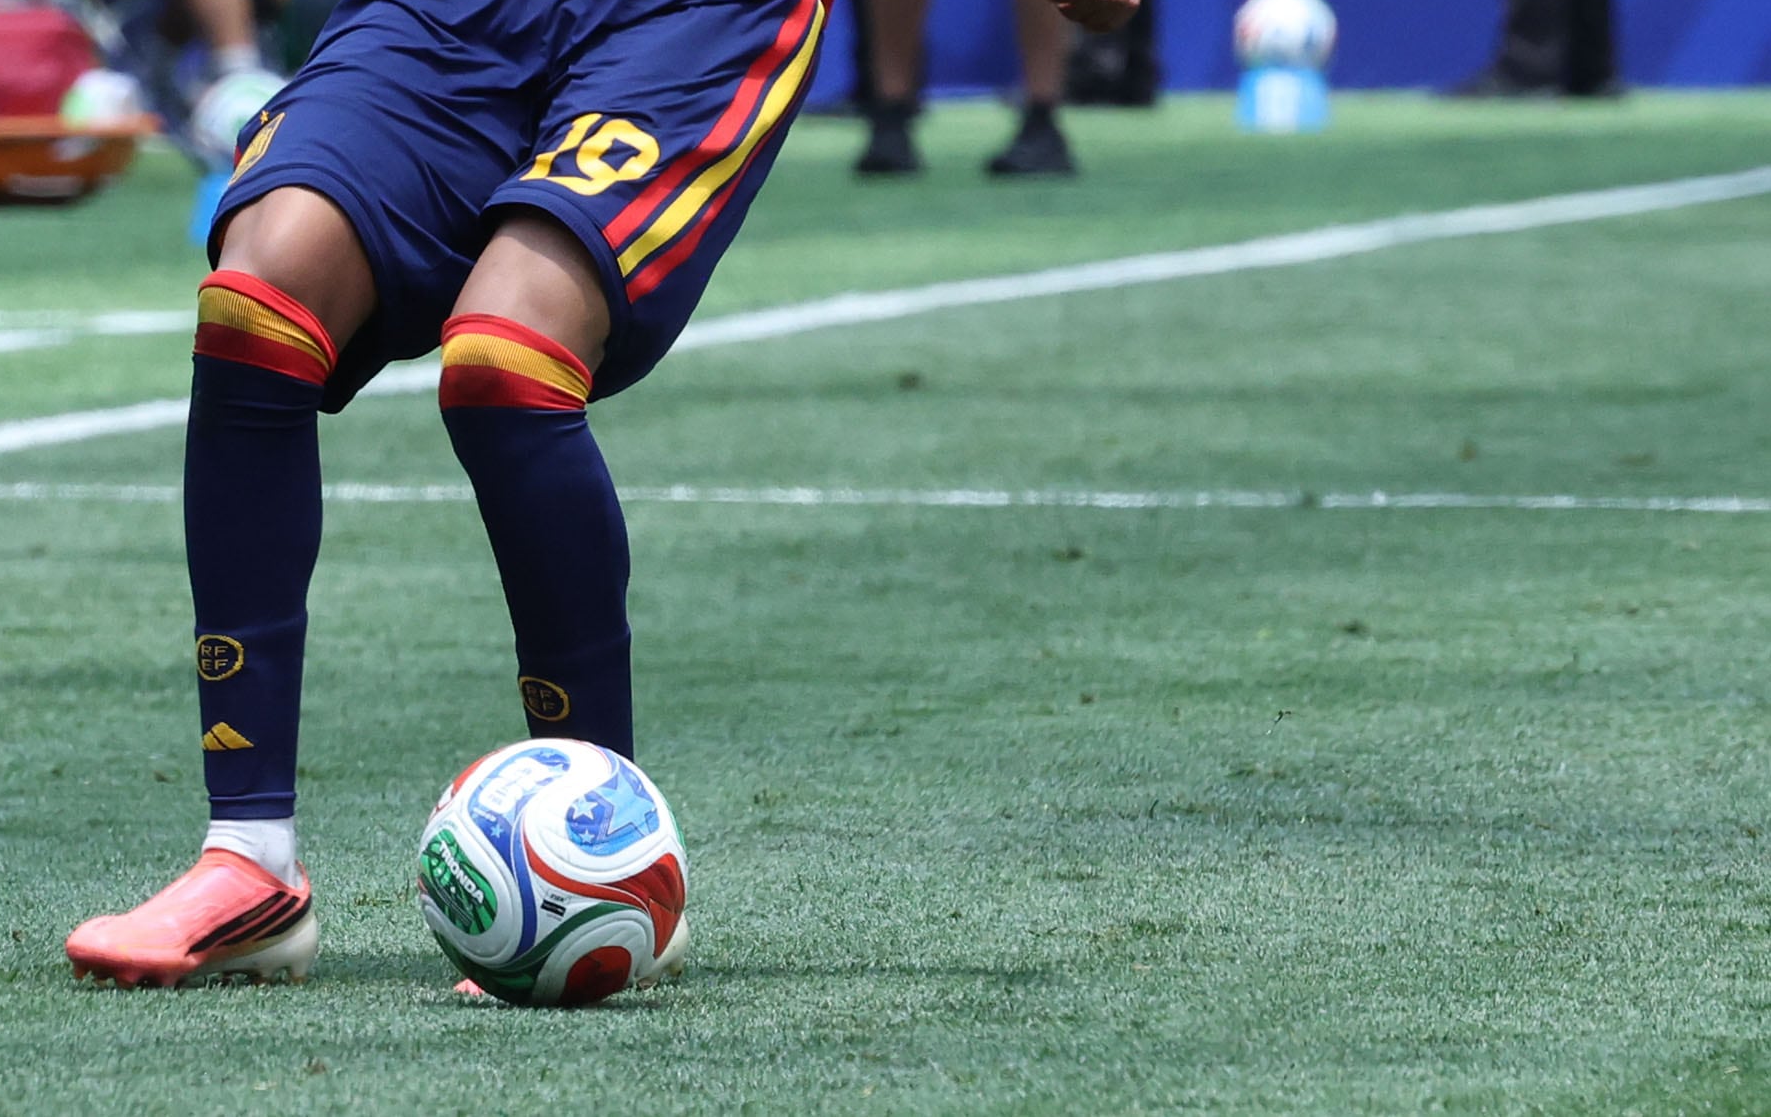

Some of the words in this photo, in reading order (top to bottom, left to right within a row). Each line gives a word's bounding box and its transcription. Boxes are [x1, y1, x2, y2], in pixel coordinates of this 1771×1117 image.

[519, 112, 660, 197] 19
[201, 644, 228, 657] RF
[201, 658, 228, 670] EF
[440, 840, 484, 904] TRIONDA
